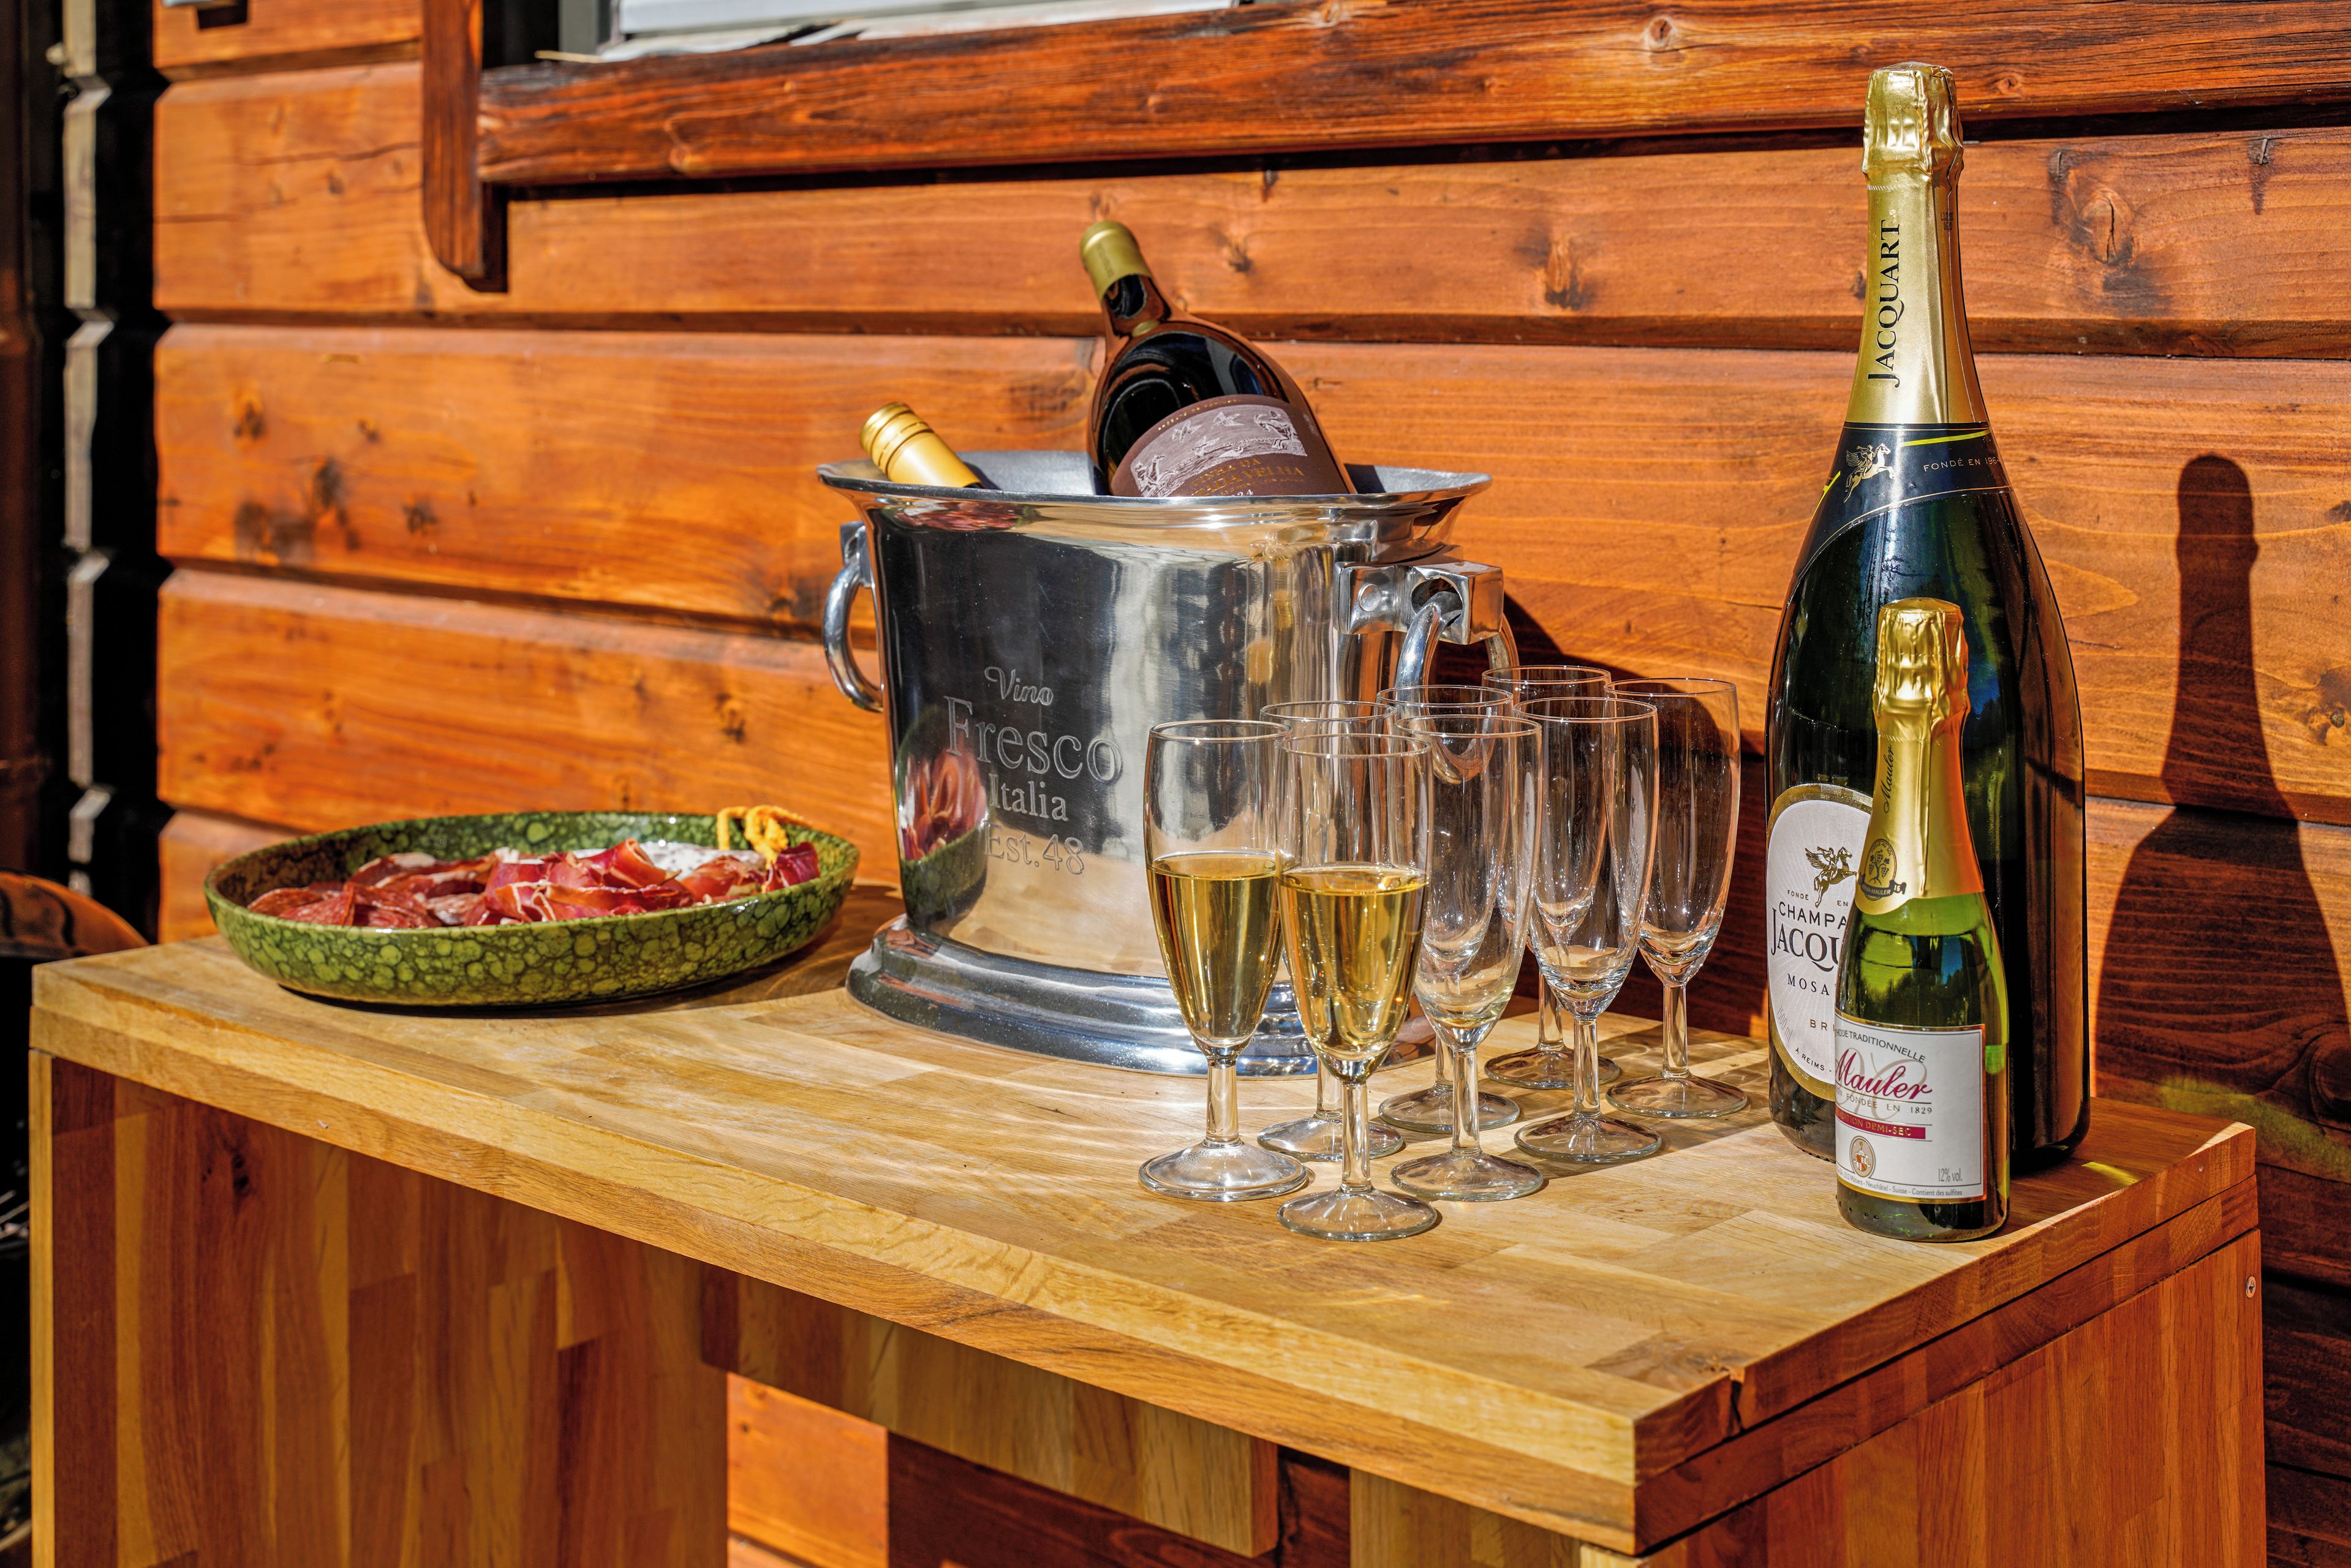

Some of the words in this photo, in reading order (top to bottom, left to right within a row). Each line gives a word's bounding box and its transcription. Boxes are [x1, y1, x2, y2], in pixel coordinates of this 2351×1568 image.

[1868, 219, 1905, 389] JACQUART
[1923, 458, 1963, 472] FONDÉ
[984, 666, 1054, 706] Vino
[944, 695, 1123, 783] Fresco
[1881, 744, 1894, 813] Mauler
[988, 773, 1069, 822] Italia
[1787, 889, 1809, 900] FONDÉ
[1779, 901, 1847, 930] CHAMPA
[1787, 973, 1830, 996] MOSA
[1810, 1019, 1835, 1031] BR
[1835, 1029, 1848, 1038] HODE
[1850, 1031, 1926, 1063] TRADITIONNELLE
[1802, 1053, 1825, 1071] REIMS
[1835, 1049, 1933, 1099] Mauler
[1846, 1093, 1877, 1109] FONDÉE
[1865, 1122, 1912, 1136] DEMI-SEC
[1938, 1168, 1951, 1182] 12%
[1952, 1168, 1963, 1182] vol.
[1866, 1180, 1889, 1191] Neuchâtel
[1892, 1186, 1908, 1194] Suisse
[1911, 1188, 1935, 1196] Contient
